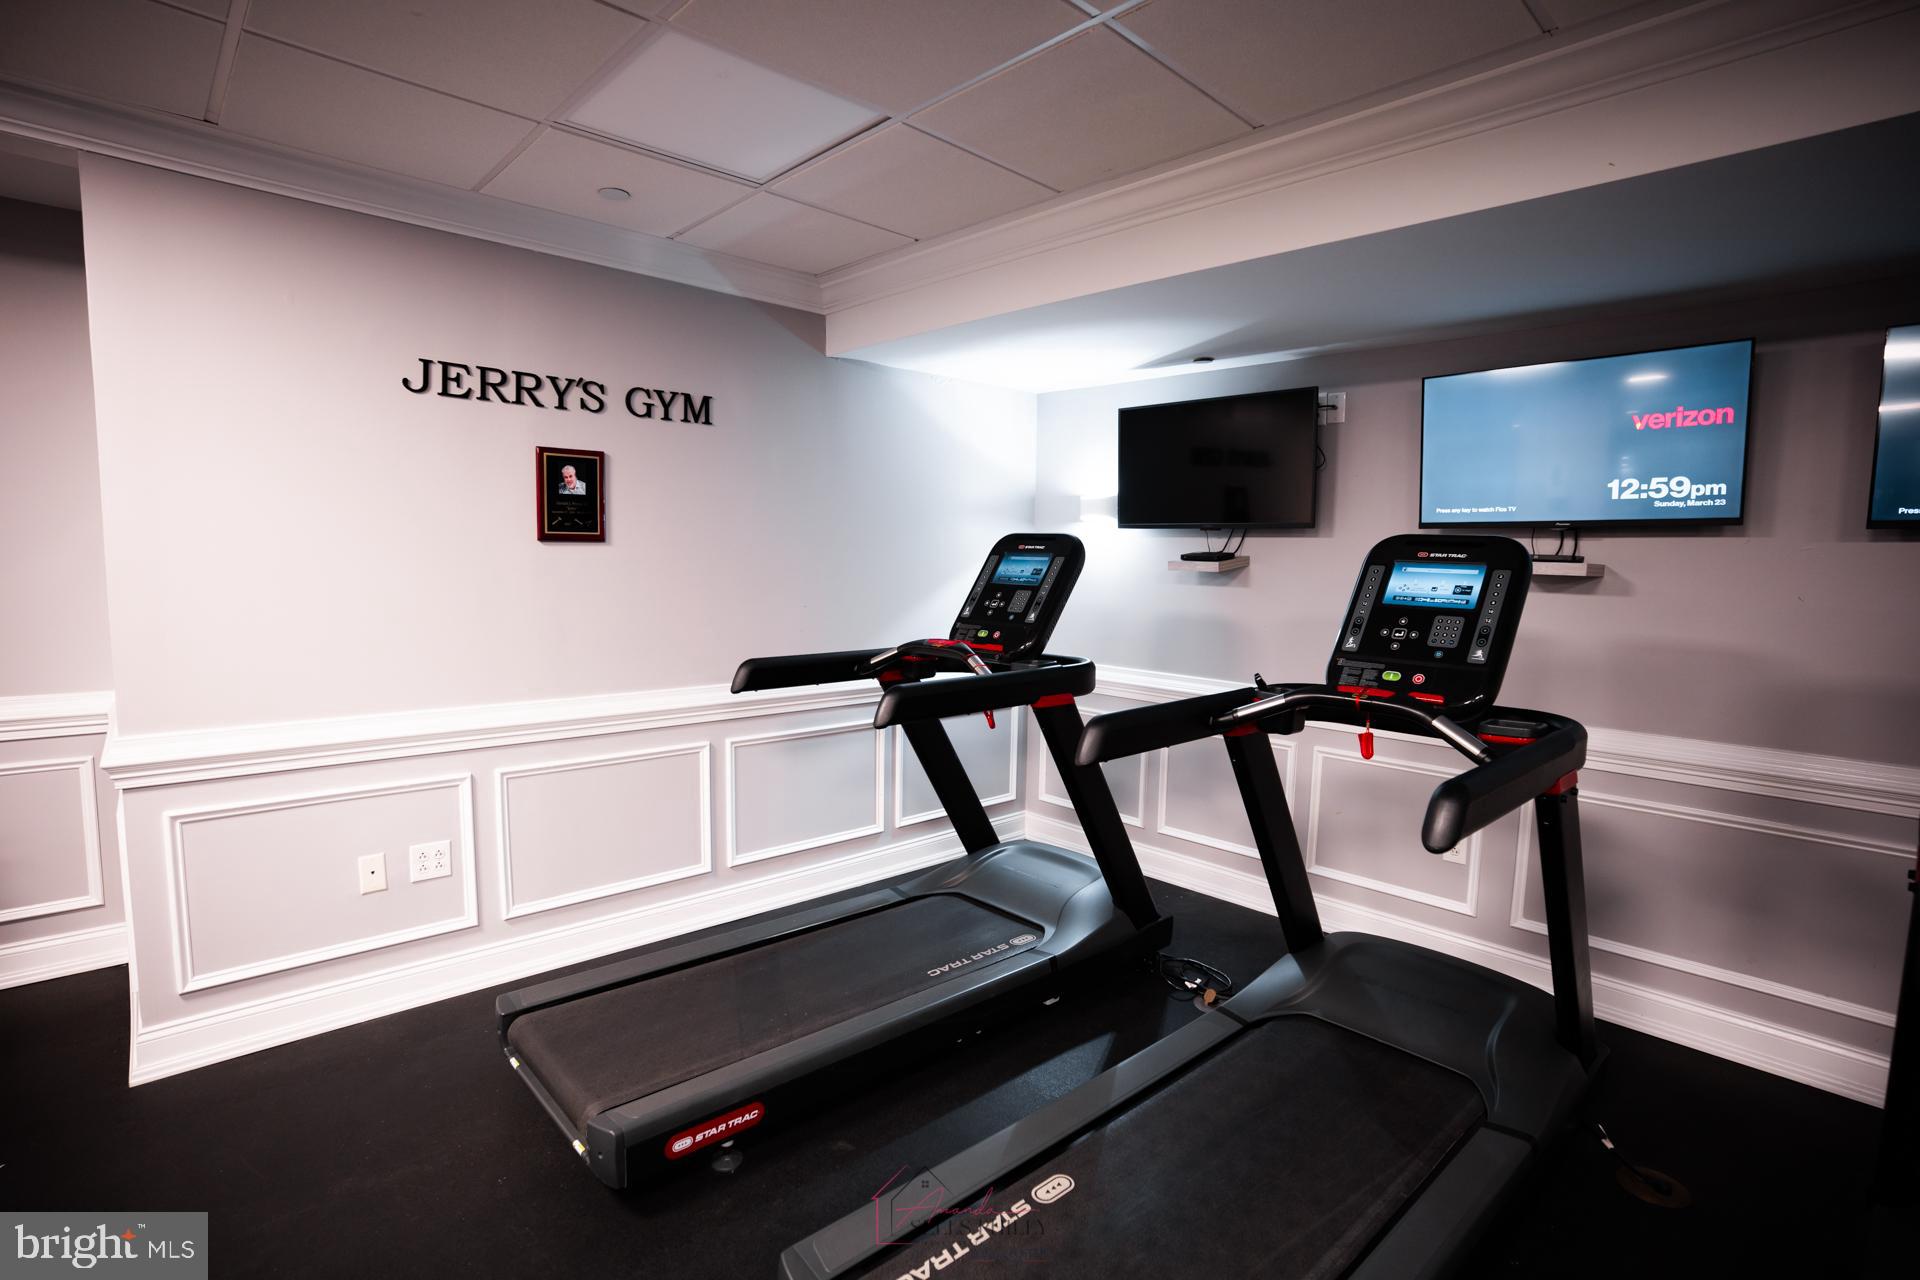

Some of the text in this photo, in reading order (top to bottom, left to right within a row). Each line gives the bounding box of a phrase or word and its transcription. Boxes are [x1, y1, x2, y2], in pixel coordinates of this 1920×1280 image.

[402, 358, 713, 425] JERRY'S GYM
[1631, 405, 1735, 430] verizon
[1607, 476, 1727, 500] 12:59pm
[1654, 498, 1727, 509] Sunday, March 23
[927, 943, 1010, 977] STAR TRAC
[695, 1109, 759, 1143] STAR TRAC
[966, 1199, 1032, 1247] STAR
